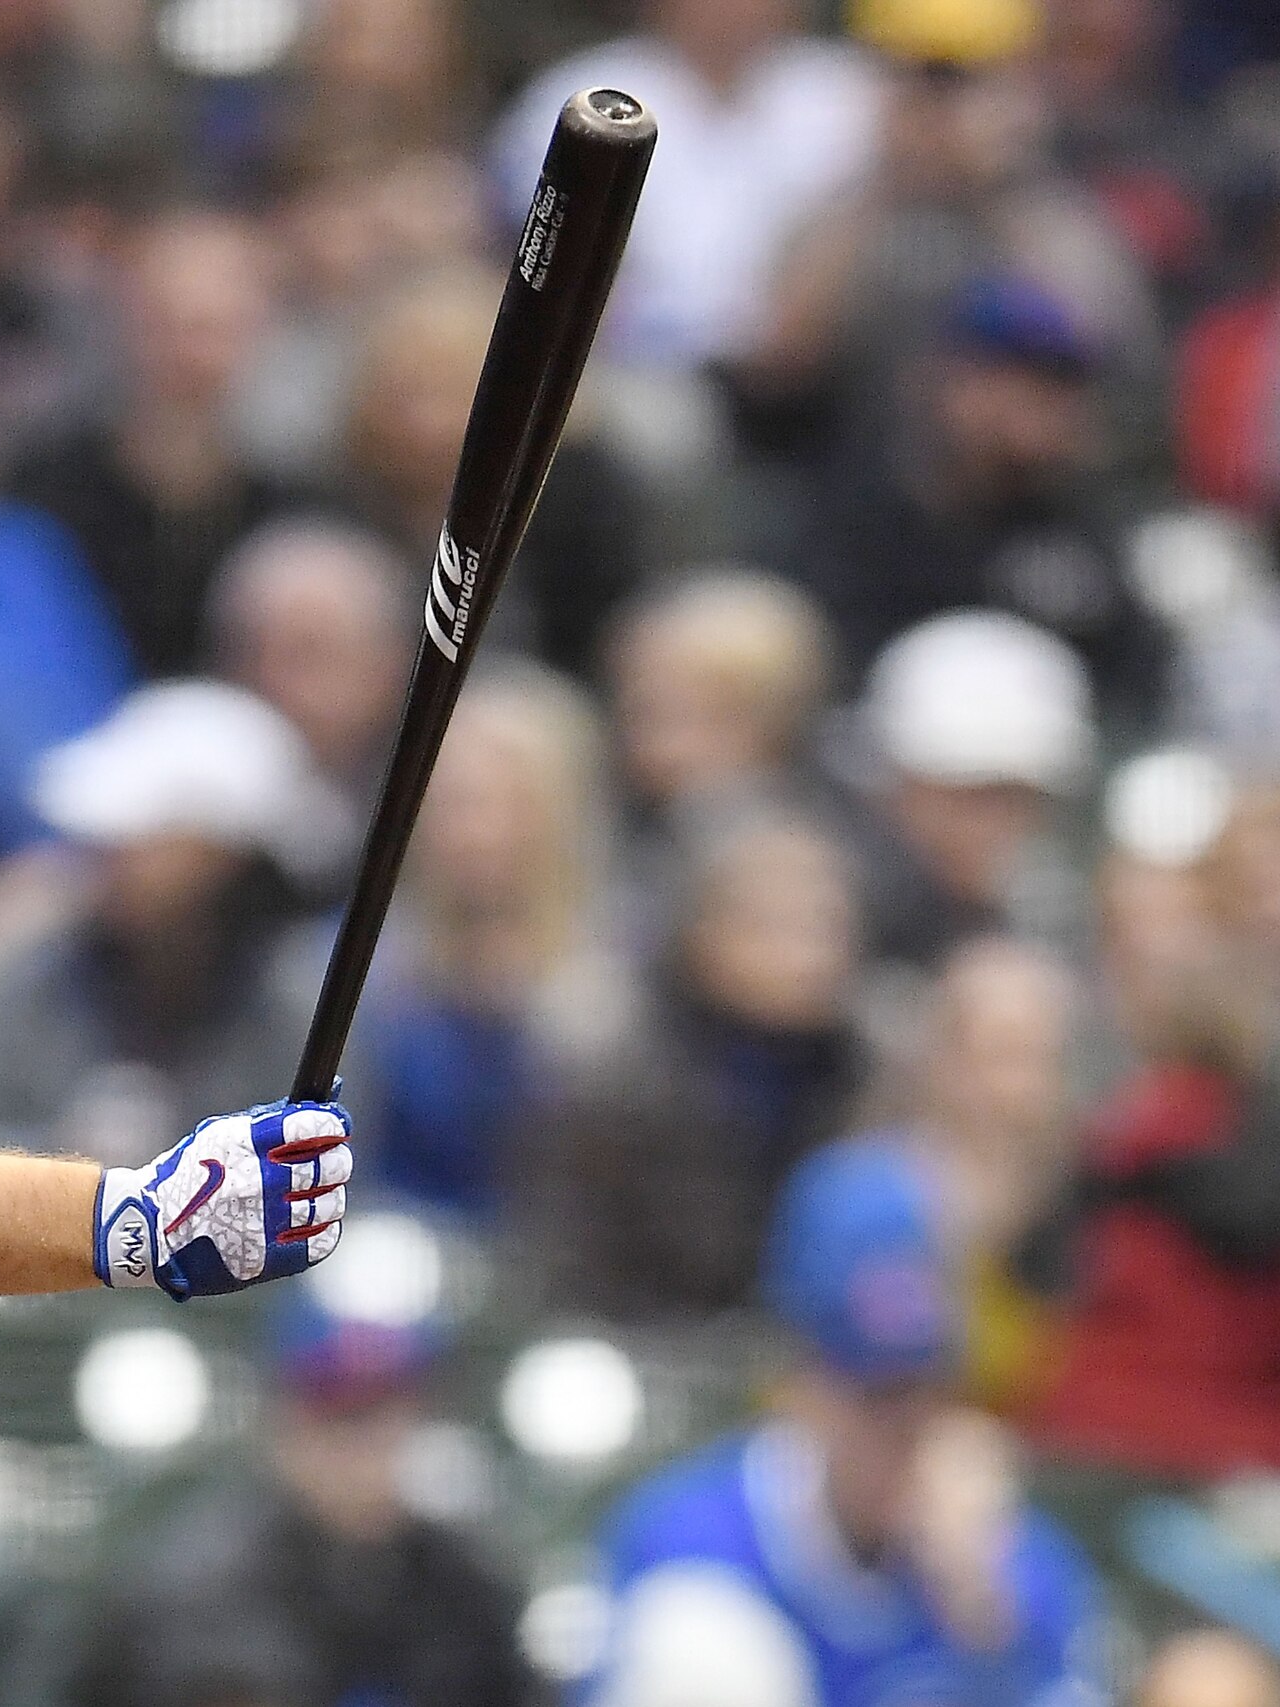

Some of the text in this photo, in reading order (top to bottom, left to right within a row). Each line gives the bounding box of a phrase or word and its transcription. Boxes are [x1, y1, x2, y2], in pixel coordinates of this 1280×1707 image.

[520, 223, 547, 282] Anthony
[536, 185, 557, 223] Rizzo
[451, 546, 480, 644] marucci
[113, 1220, 147, 1278] MVP
